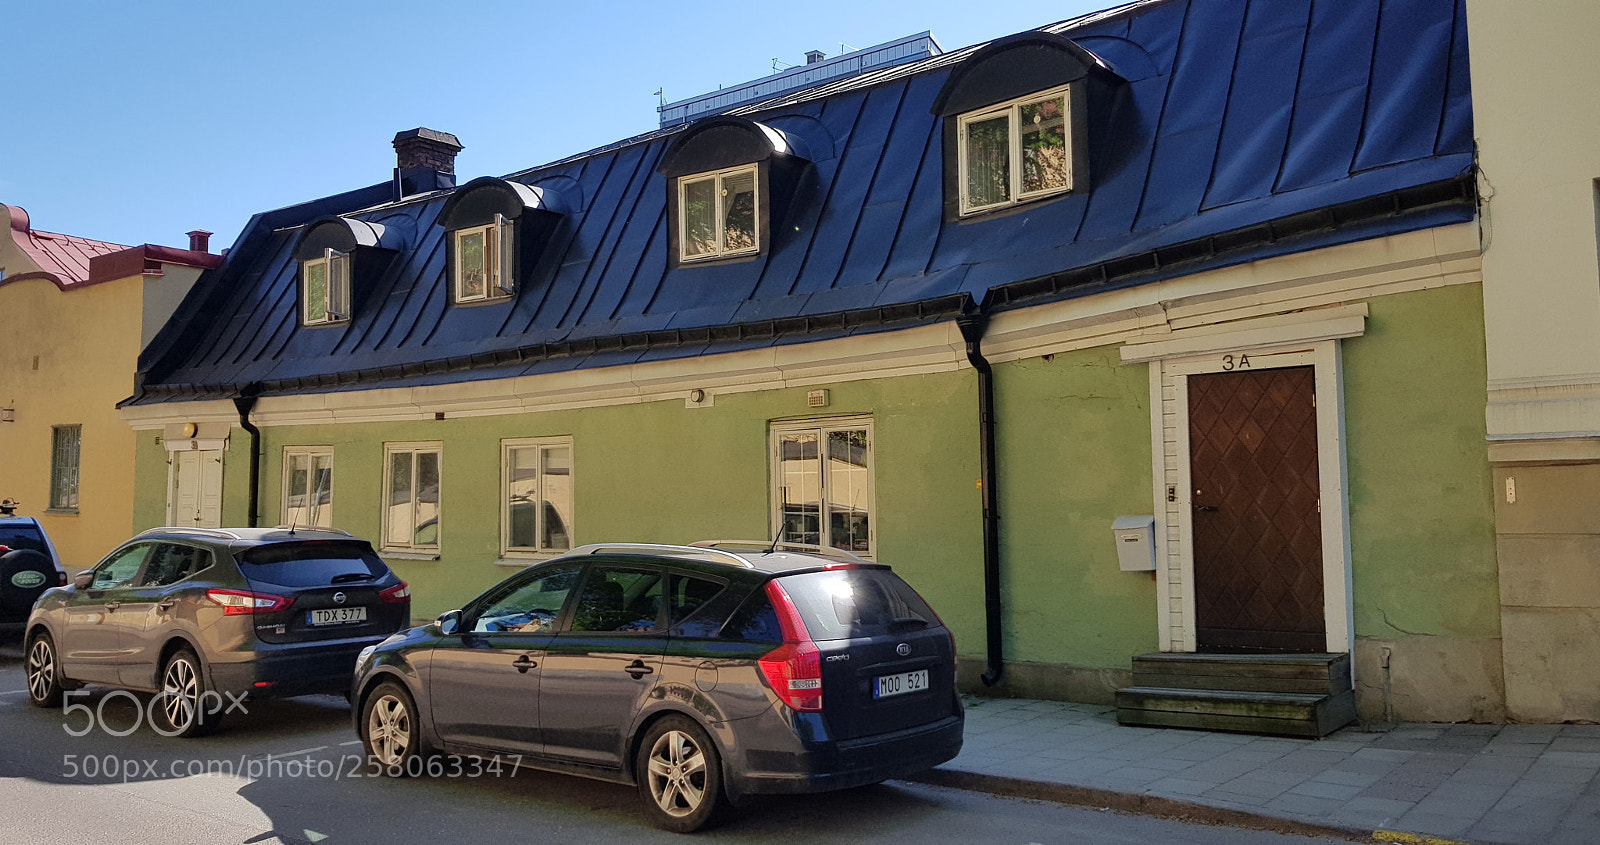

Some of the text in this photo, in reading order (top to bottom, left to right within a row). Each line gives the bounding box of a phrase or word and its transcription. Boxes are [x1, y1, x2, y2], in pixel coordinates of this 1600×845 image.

[316, 608, 362, 622] TDX 377
[907, 672, 926, 690] 521
